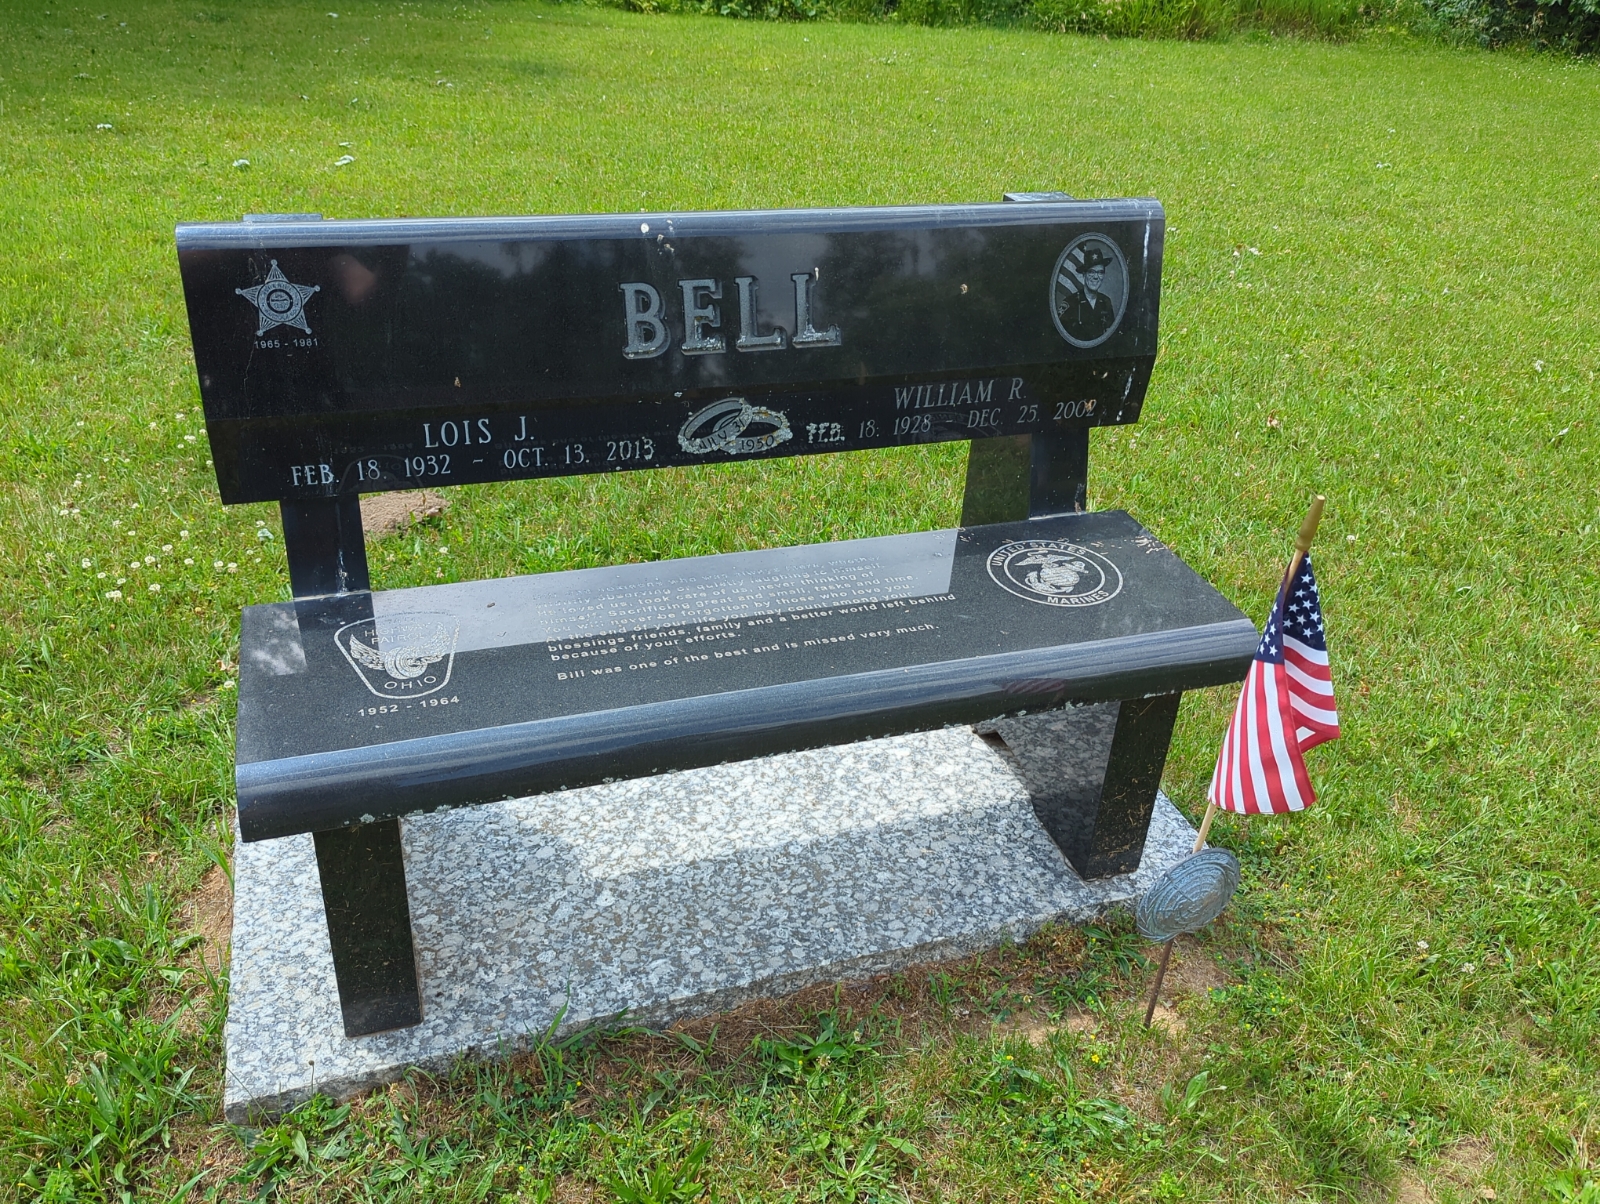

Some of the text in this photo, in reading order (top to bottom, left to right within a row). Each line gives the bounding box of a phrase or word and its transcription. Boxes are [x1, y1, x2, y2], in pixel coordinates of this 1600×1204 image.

[618, 272, 842, 359] BELL
[254, 340, 280, 349] 1965
[293, 338, 318, 347] 1981
[894, 377, 1027, 410] WILLIAM R.
[423, 415, 535, 448] LOIS J.
[732, 418, 746, 433] 31
[893, 414, 931, 436] 1928
[967, 408, 1003, 428] DEC.
[1017, 404, 1040, 424] 25.
[1053, 399, 1097, 420] 2002
[740, 435, 774, 451] 1950
[291, 464, 340, 486] FEB.
[357, 459, 387, 481] 18.
[404, 454, 451, 478] 1932
[503, 447, 549, 469] OCT.
[565, 444, 590, 464] 13.
[606, 438, 654, 461] 2013
[991, 541, 1087, 566] UNITED STATES
[562, 603, 604, 614] loved
[638, 595, 671, 605] took
[676, 592, 707, 600] care
[712, 588, 726, 597] of
[757, 581, 796, 592] never
[800, 573, 858, 586] thinking
[861, 570, 875, 579] of
[598, 588, 671, 602] observing
[607, 602, 690, 617] Sacrificing
[695, 596, 733, 608] great
[738, 593, 763, 602] and
[768, 588, 811, 599] small,
[814, 582, 852, 592] tasks
[856, 579, 881, 588] and
[884, 575, 919, 584] time.
[610, 615, 652, 626] never
[657, 612, 676, 620] be
[680, 603, 749, 617] forgotten
[754, 600, 771, 608] by
[775, 594, 815, 605] those
[819, 588, 848, 600] who
[851, 586, 881, 596] love
[884, 583, 915, 593] you.
[1047, 590, 1110, 605] MARINES
[548, 635, 626, 652] blessings
[630, 627, 692, 642] friends,
[695, 620, 742, 634] family
[747, 616, 774, 627] and
[791, 608, 834, 621] better
[838, 603, 878, 615] world
[881, 600, 906, 610] left
[908, 593, 957, 606] behind
[568, 631, 593, 640] the
[599, 626, 628, 637] end
[633, 622, 648, 632] of
[653, 620, 687, 631] your
[692, 615, 717, 625] life
[721, 612, 749, 622] you
[753, 607, 782, 617] may
[787, 601, 829, 612] count
[832, 595, 879, 607] among
[882, 591, 913, 601] your
[371, 632, 425, 645] PATROL
[551, 631, 742, 662] because of your efforts.
[557, 622, 940, 681] Bill was one of the best and is missed very much.
[384, 675, 437, 690] OHIO
[358, 704, 399, 717] 1952
[420, 696, 460, 708] 1964
